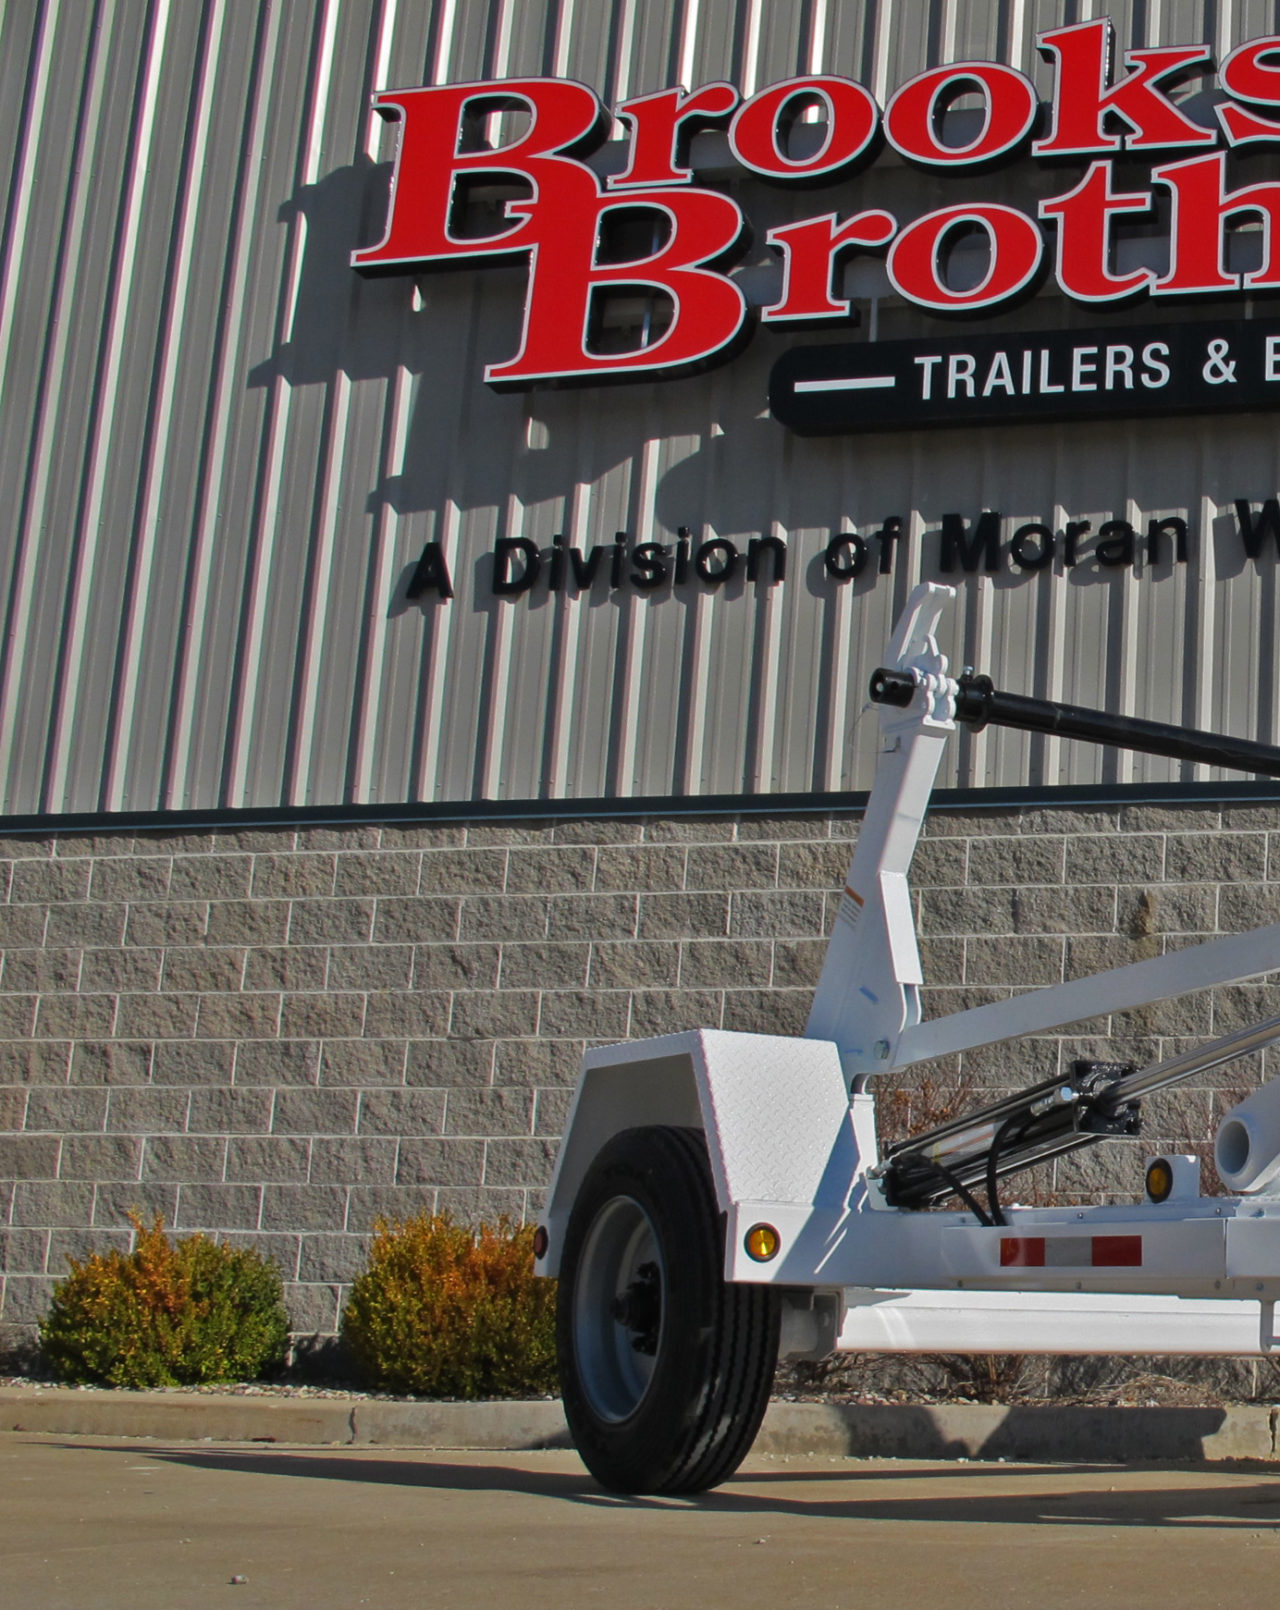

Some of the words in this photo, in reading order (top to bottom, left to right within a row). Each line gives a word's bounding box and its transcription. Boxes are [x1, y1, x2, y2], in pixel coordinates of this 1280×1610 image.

[913, 340, 1171, 402] TRAILERS
[1202, 338, 1238, 385] &
[405, 541, 455, 600] A
[491, 526, 788, 596] Division
[824, 516, 903, 580] of
[940, 511, 1190, 573] Moran
